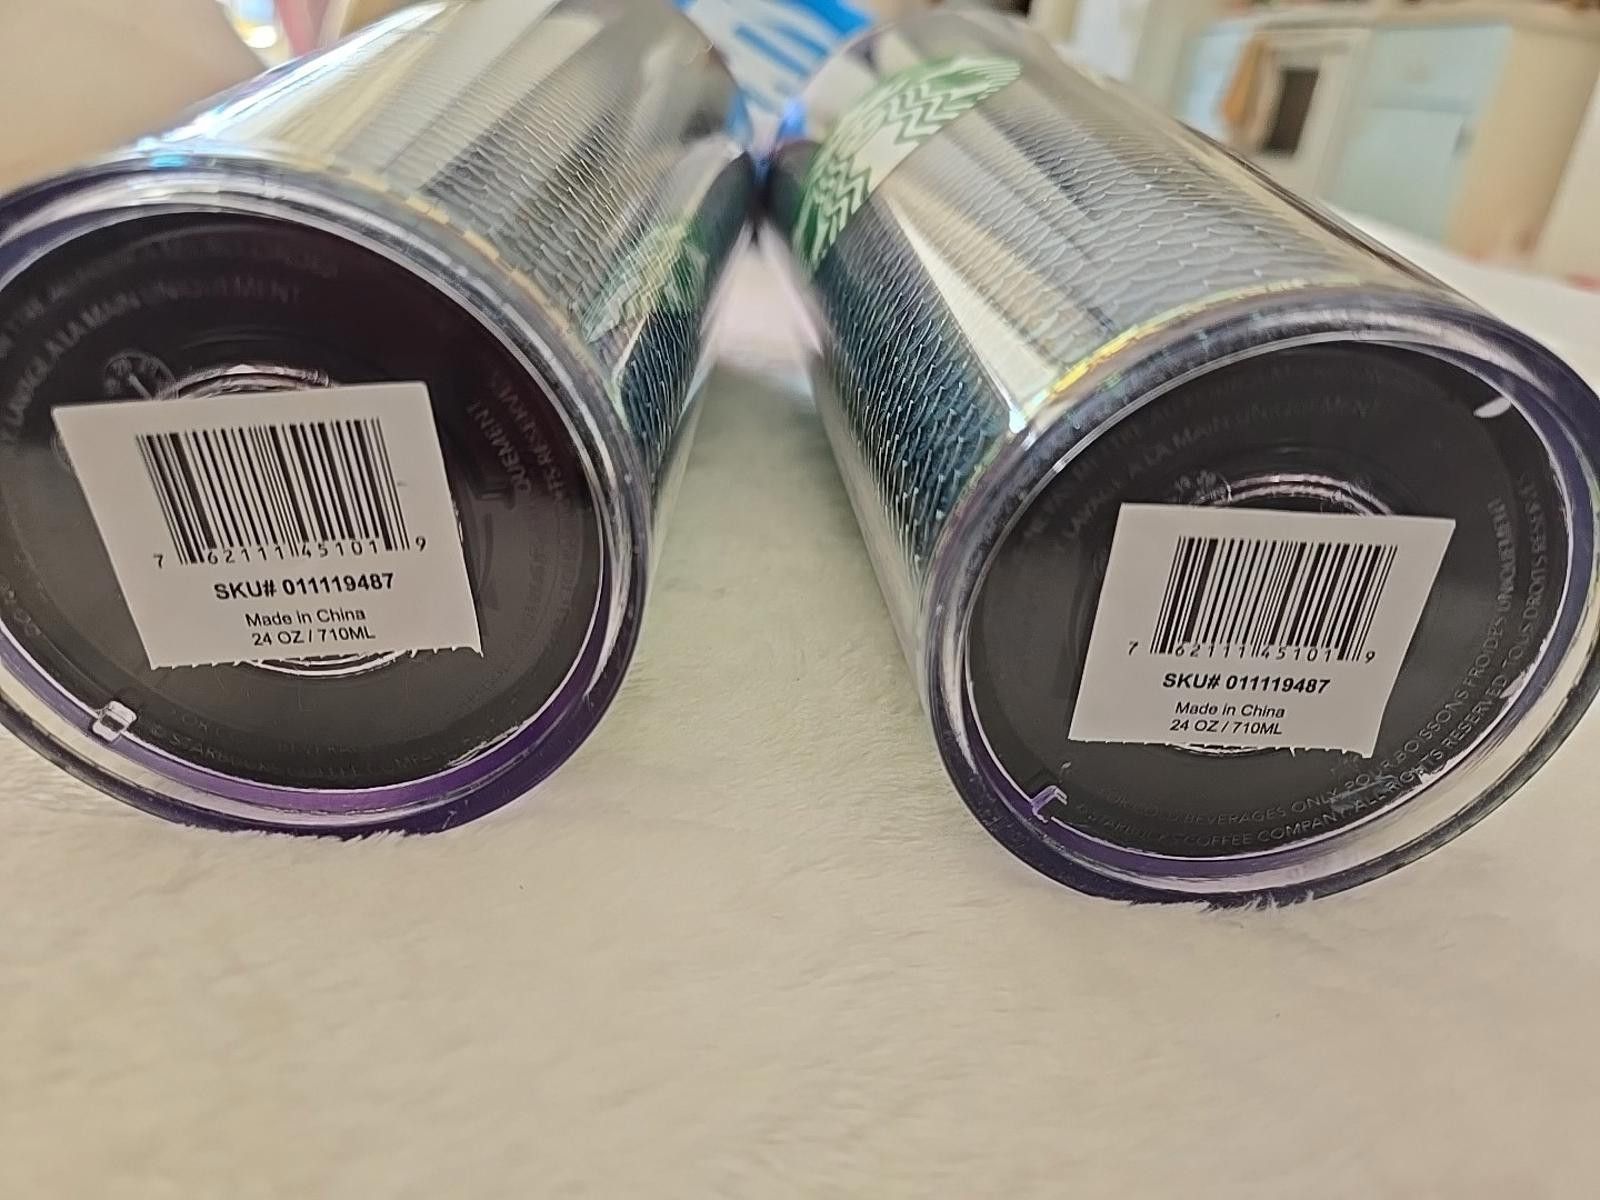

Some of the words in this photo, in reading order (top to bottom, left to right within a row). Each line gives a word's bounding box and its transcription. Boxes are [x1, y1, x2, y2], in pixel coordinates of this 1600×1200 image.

[153, 554, 164, 569] 7
[416, 536, 427, 551] 9
[214, 579, 276, 600] SKU#
[282, 572, 394, 595] 011119487
[245, 612, 293, 627] Made
[297, 609, 312, 623] in
[316, 607, 366, 622] China
[252, 632, 272, 646] 24
[277, 630, 303, 644] OZ
[308, 628, 314, 643] /
[317, 626, 376, 642] 710ML
[1128, 641, 1139, 656] 7
[1365, 651, 1376, 664] 9
[1162, 672, 1221, 690] SKU#
[1226, 675, 1331, 694] 011119487
[1175, 701, 1218, 715] Made
[1222, 703, 1236, 716] in
[1241, 704, 1285, 718] China
[1183, 806, 1287, 825] BEVERAGES
[1291, 788, 1337, 813] ONLY
[1393, 688, 1470, 765] BOISSONS
[1462, 614, 1507, 688] FROIDES
[1169, 719, 1190, 732] 24
[1194, 719, 1219, 733] OZ
[1221, 720, 1230, 733] /
[1233, 721, 1283, 735] 710ML
[1184, 832, 1253, 848] COFFEE
